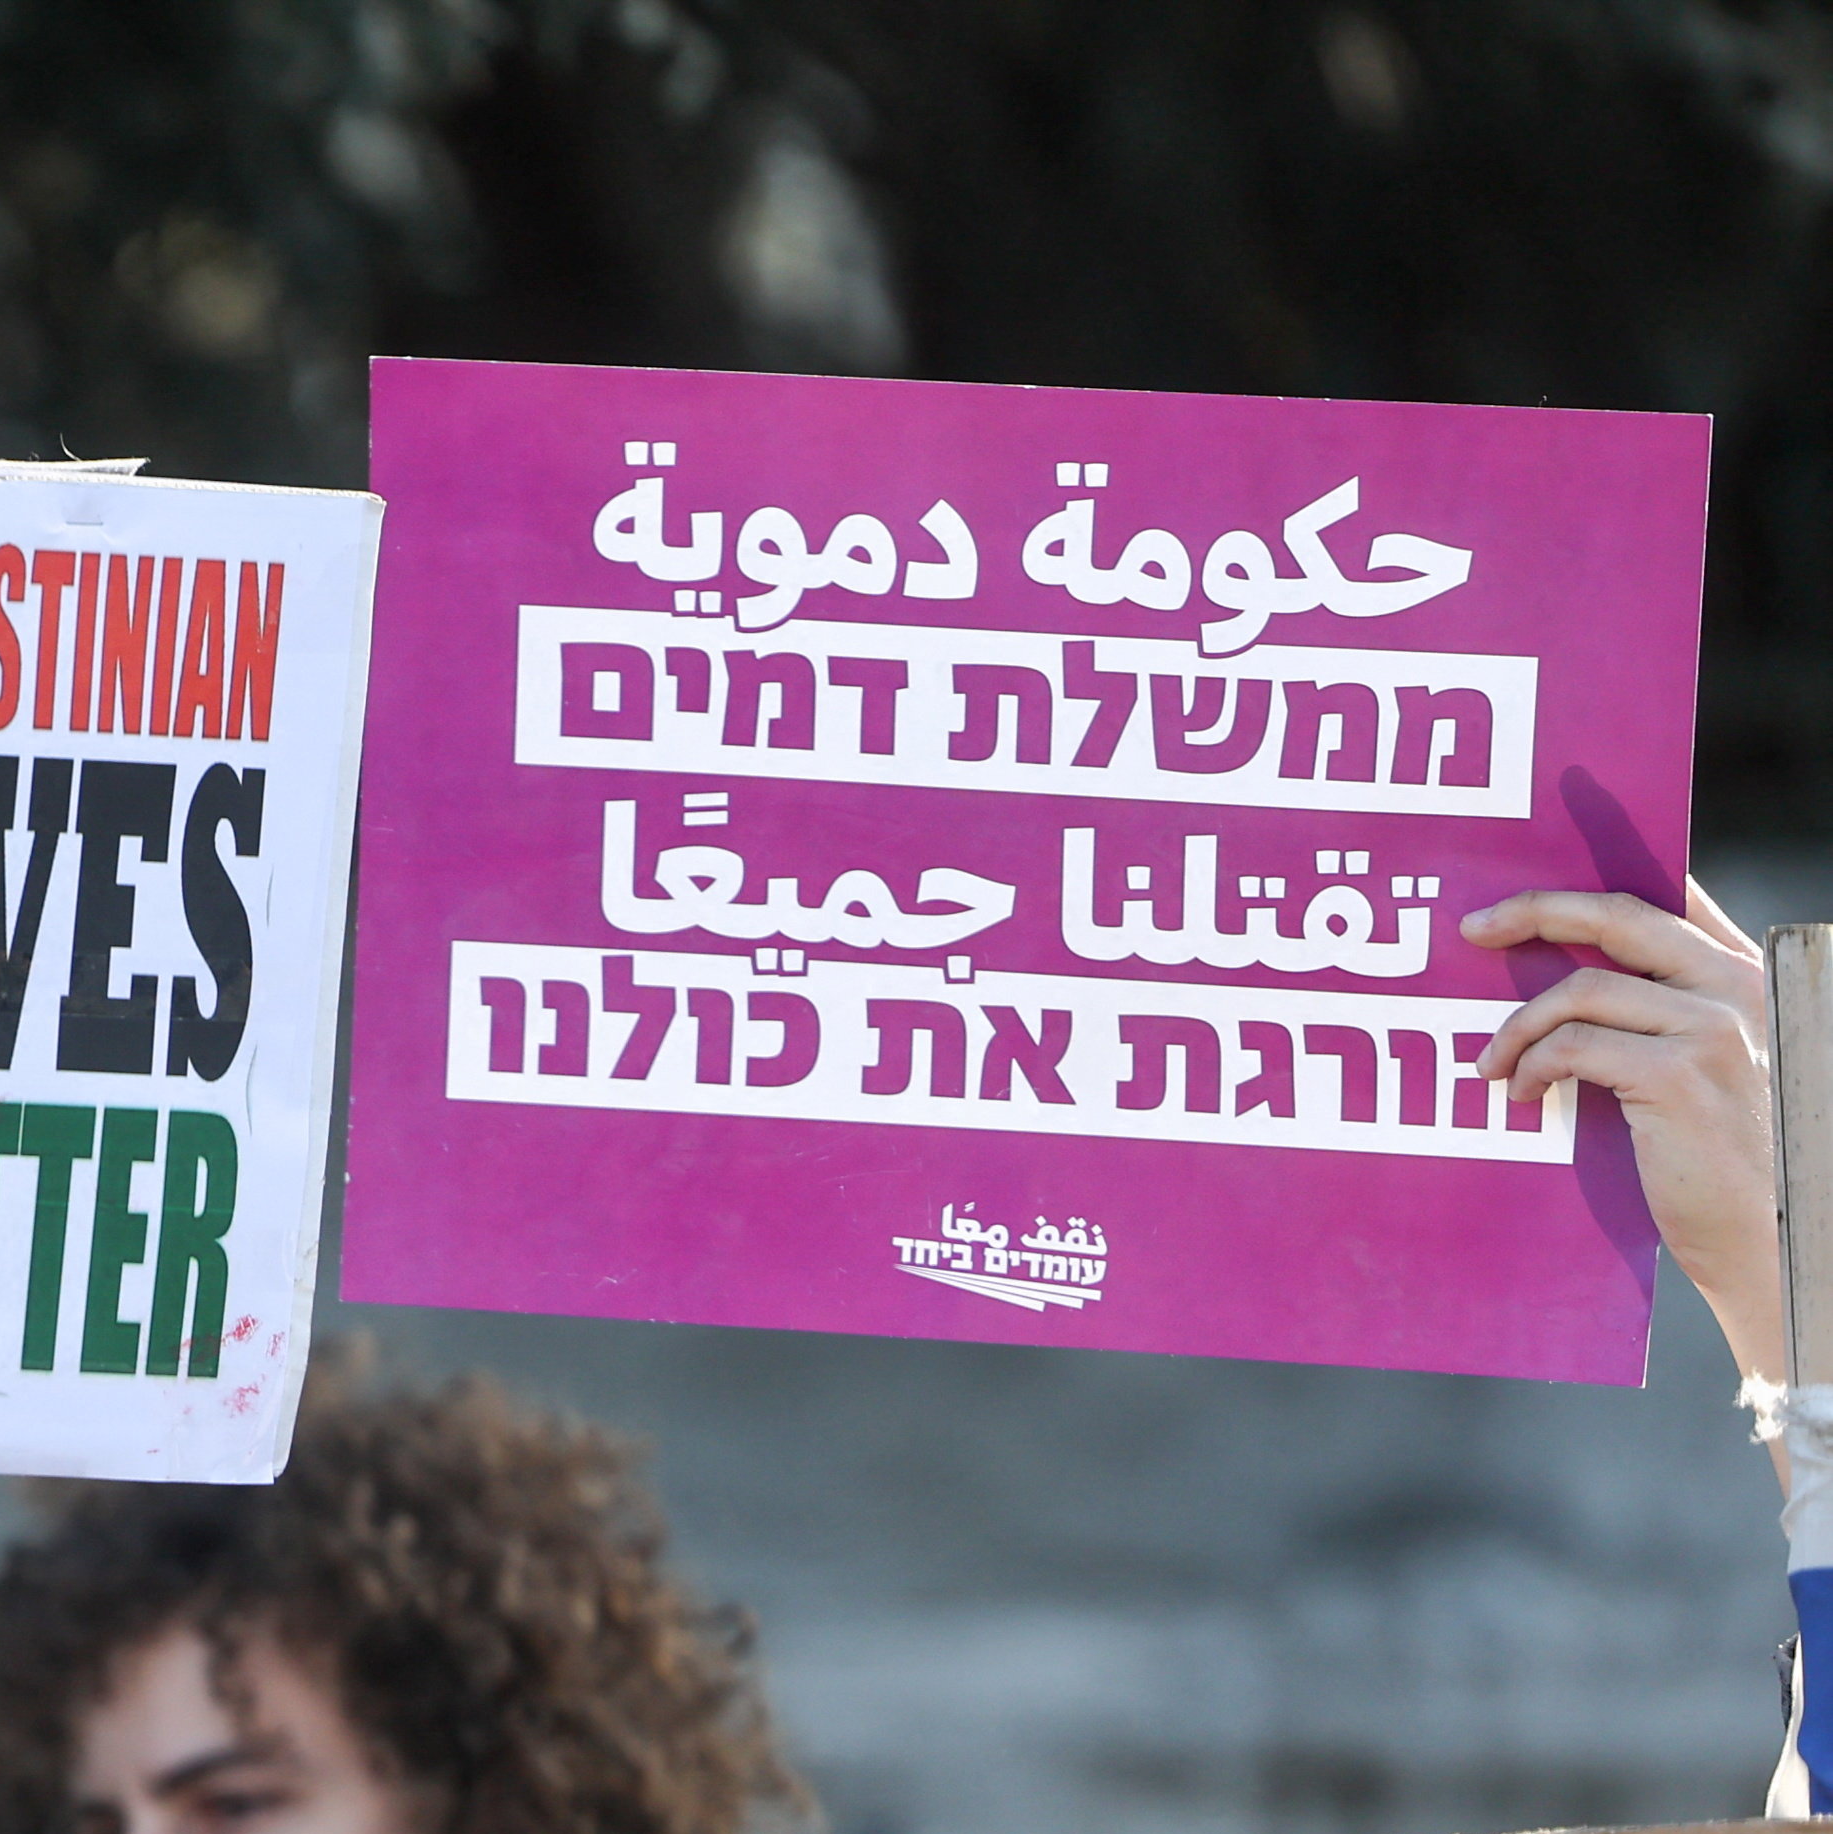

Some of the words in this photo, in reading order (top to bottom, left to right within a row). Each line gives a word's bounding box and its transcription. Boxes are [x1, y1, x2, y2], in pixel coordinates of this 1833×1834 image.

[593, 441, 978, 630] دموية
[1022, 463, 1473, 655] حكومة
[561, 642, 909, 757] דמים
[948, 641, 1494, 788] ממשלת
[600, 792, 1016, 979] جميعًا
[1061, 828, 1441, 978] تقتلنا
[479, 954, 822, 1089] כולנו
[862, 999, 1075, 1105] את
[892, 1237, 973, 1271] ביחד
[983, 1247, 1107, 1286] עומדים
[1020, 1215, 1108, 1256] نقف
